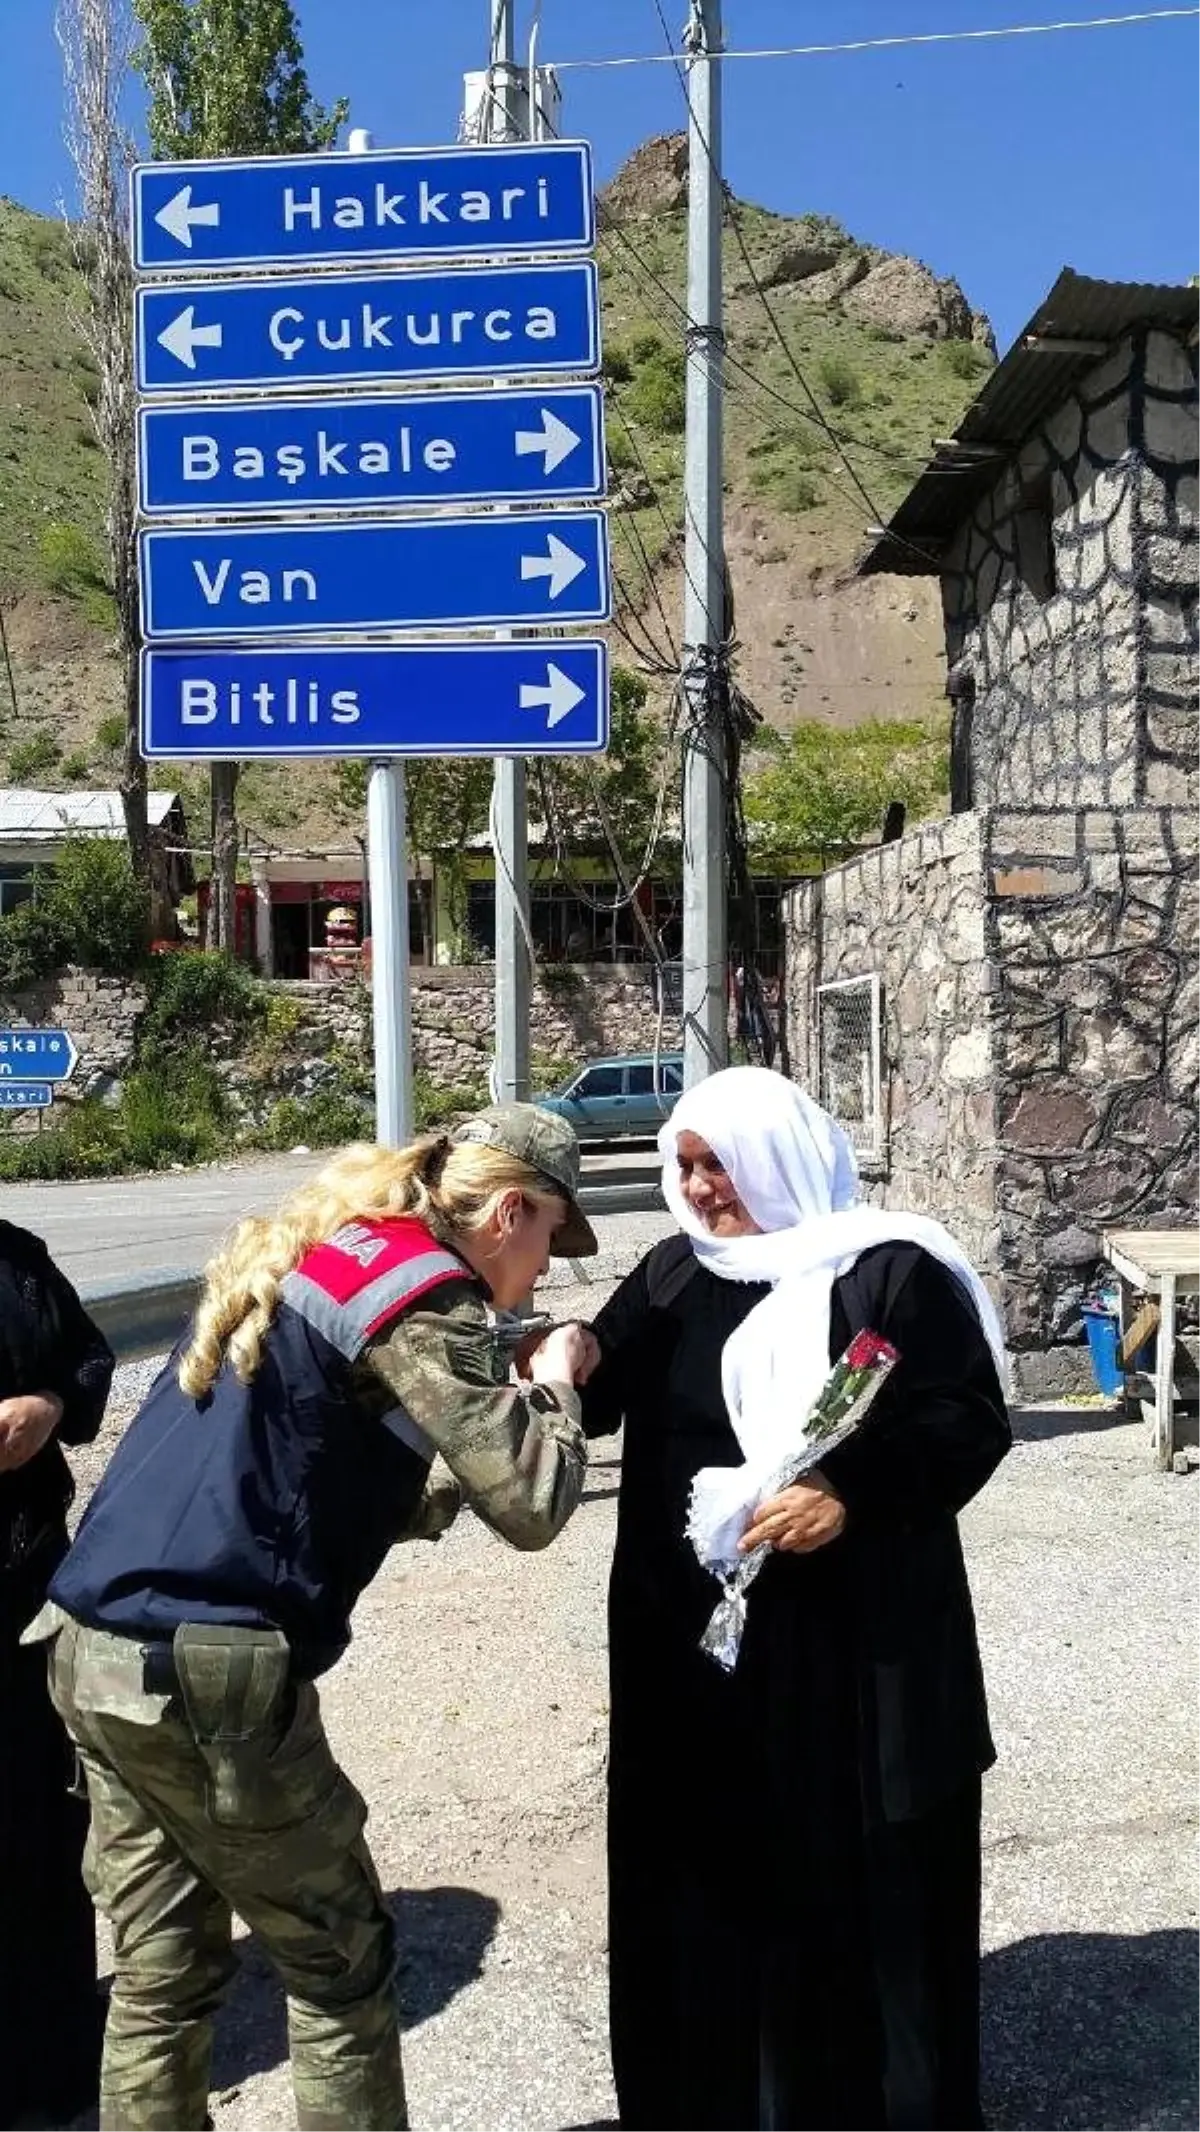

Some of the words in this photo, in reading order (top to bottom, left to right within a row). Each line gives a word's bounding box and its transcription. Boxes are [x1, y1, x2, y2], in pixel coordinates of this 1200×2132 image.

[283, 178, 549, 232] Hakkari
[268, 303, 557, 361] Çukurca
[182, 427, 457, 485] Başkale
[192, 558, 317, 605] Van
[180, 678, 361, 725] Bitlis
[0, 1089, 44, 1102] kari
